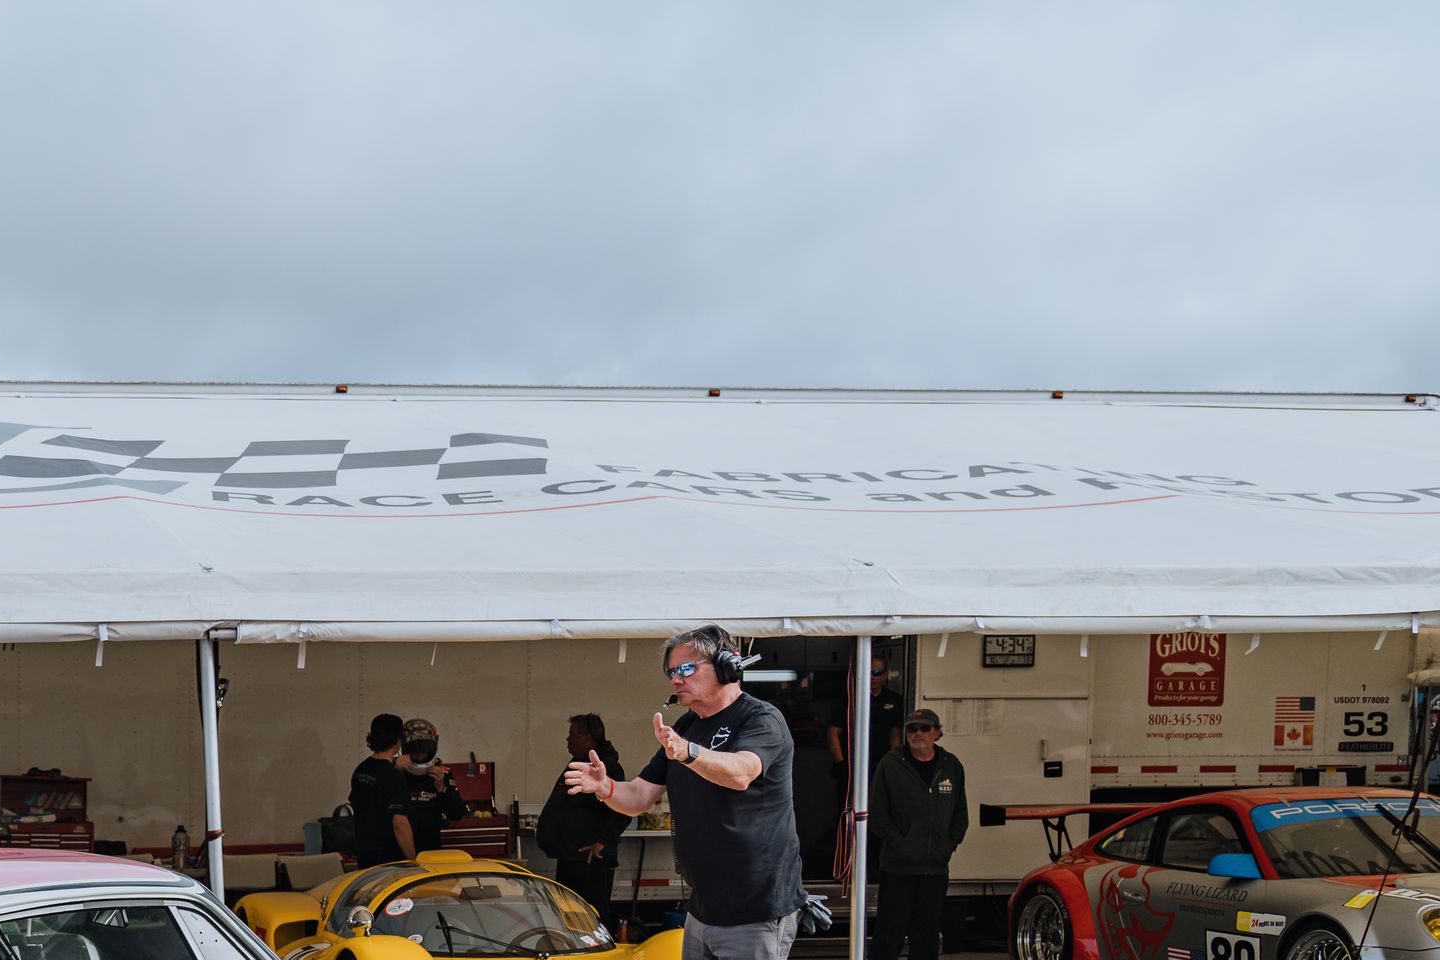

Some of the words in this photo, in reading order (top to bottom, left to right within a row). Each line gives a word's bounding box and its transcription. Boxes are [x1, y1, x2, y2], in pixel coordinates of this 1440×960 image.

[211, 489, 504, 509] RACE
[540, 478, 832, 502] CARS
[863, 484, 1056, 503] and
[1156, 680, 1216, 691] GARAGE
[1334, 696, 1360, 704] USDOT
[1148, 713, 1222, 726] 800-345-5789
[1343, 711, 1389, 737] 53
[1166, 881, 1206, 897] FLYING
[1205, 885, 1248, 903] LIZARD
